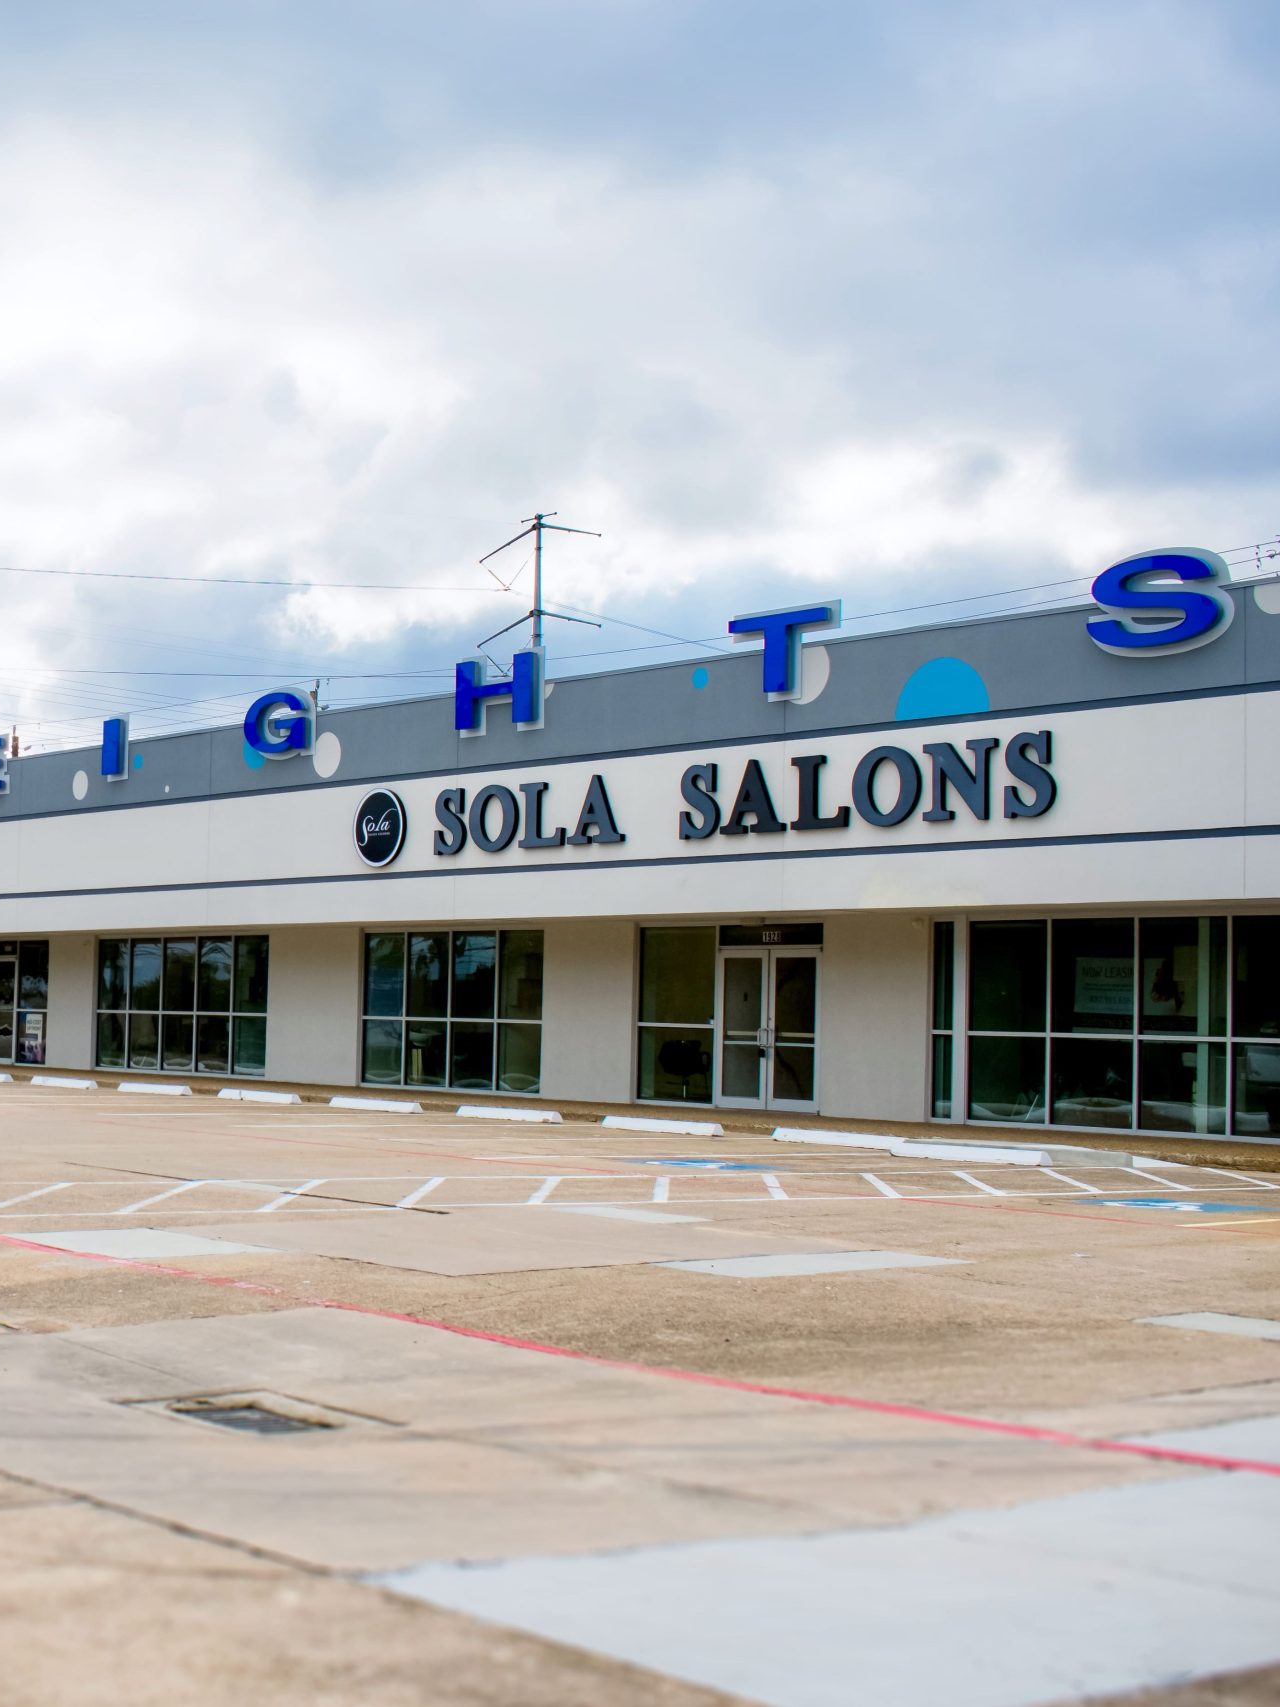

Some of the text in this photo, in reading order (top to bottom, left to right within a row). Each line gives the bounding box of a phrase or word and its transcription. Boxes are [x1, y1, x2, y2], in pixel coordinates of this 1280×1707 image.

[358, 808, 397, 846] Sola
[434, 730, 1058, 856] SOLA SALONS
